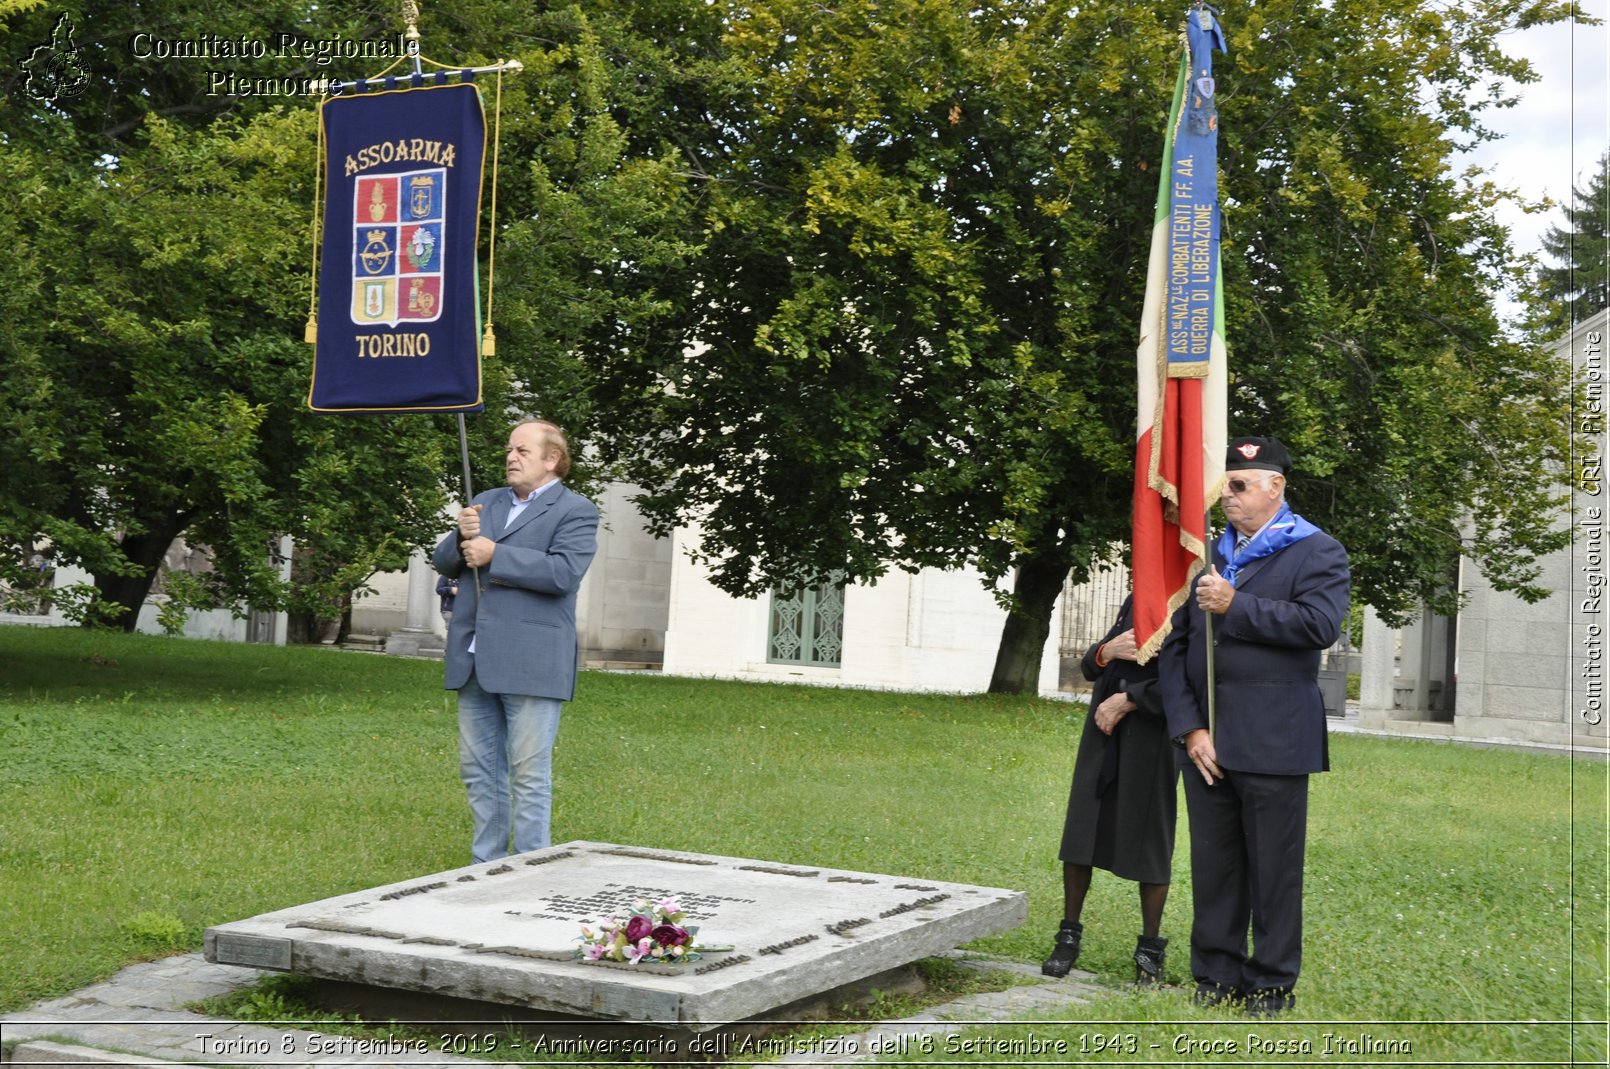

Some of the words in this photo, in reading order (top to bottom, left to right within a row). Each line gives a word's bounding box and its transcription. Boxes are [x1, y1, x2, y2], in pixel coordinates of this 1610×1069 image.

[345, 139, 457, 177] ASSOARMA
[1172, 204, 1192, 285] COMBATTENTI
[1192, 203, 1212, 283] LIBERAZIONE
[1191, 289, 1209, 301] DI
[356, 333, 431, 358] TORINO
[1191, 307, 1209, 355] GUERRA
